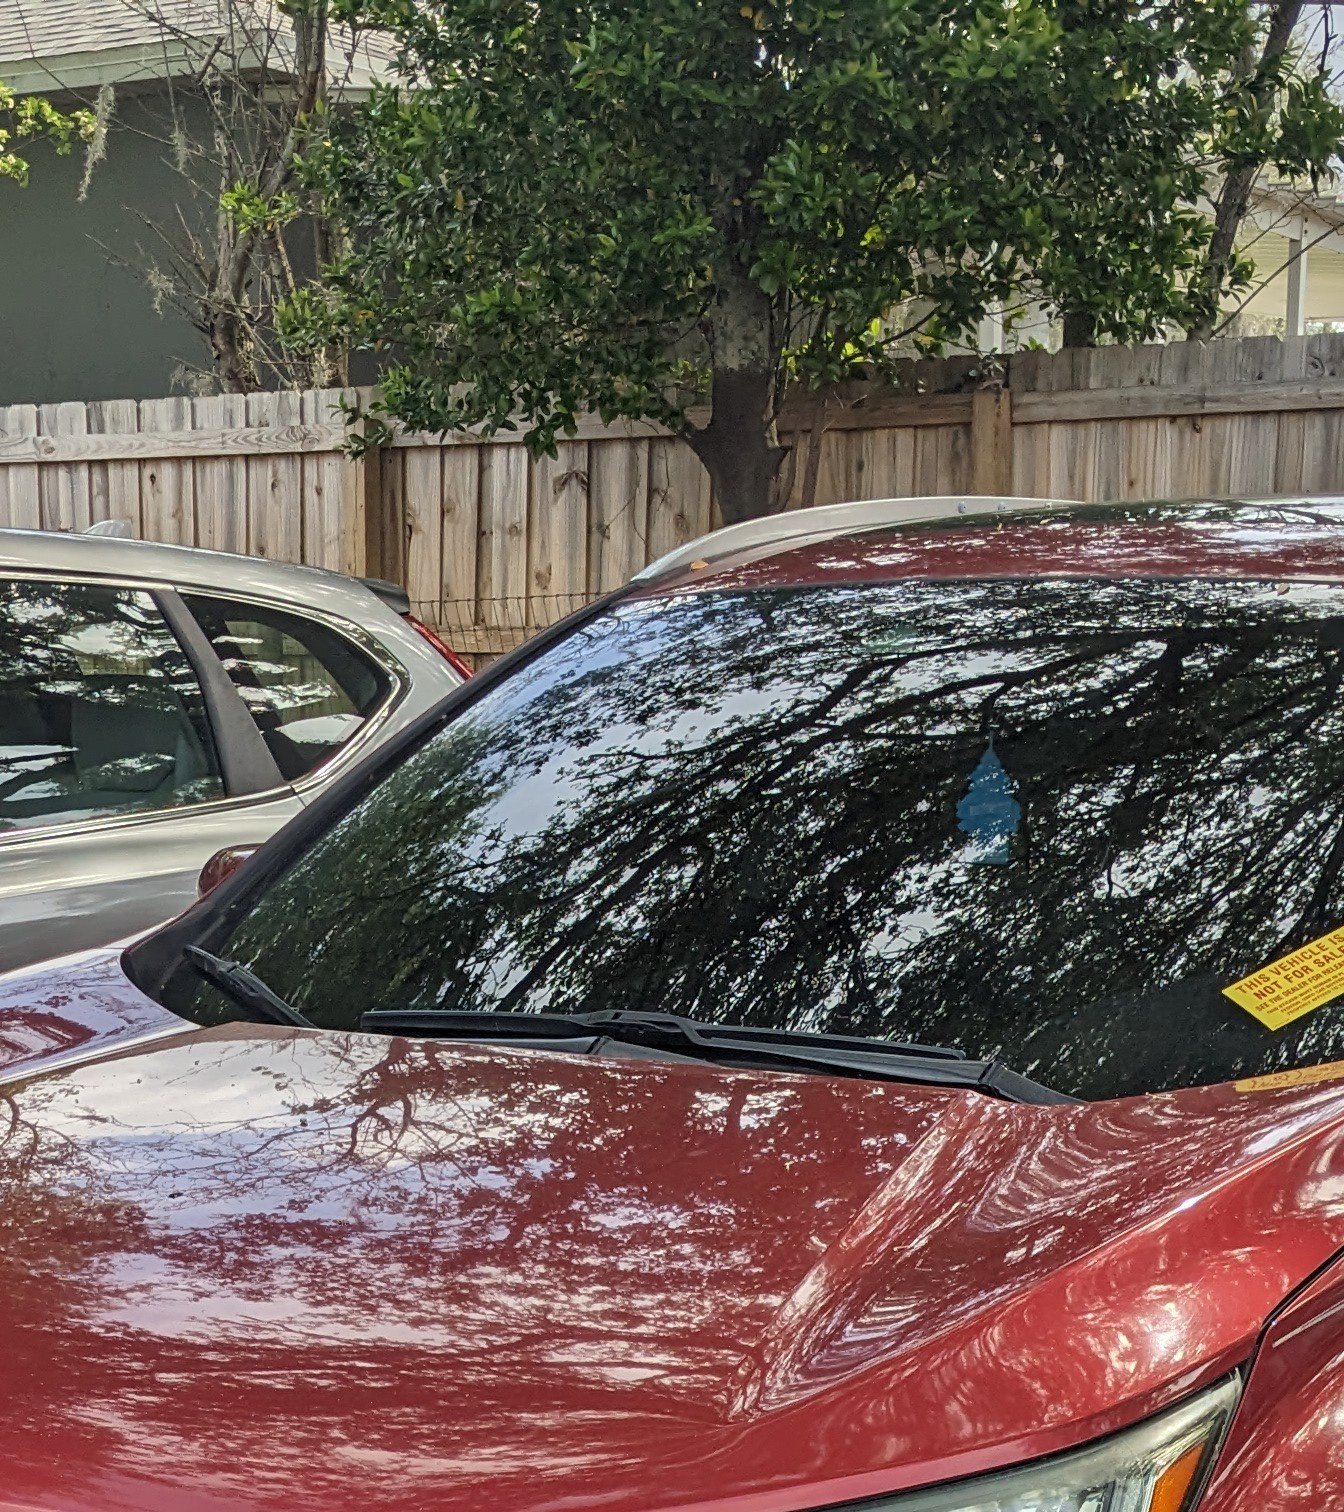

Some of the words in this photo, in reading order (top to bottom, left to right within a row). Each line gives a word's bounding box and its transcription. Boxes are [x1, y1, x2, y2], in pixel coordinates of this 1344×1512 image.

[1236, 973, 1270, 994] THIS
[1271, 943, 1328, 975] VEHICLE
[1328, 934, 1344, 945] IS
[1253, 981, 1283, 1000] NOT
[1283, 965, 1313, 983] FOR
[1269, 995, 1282, 1004] THE
[1282, 981, 1308, 997] DEALER
[1308, 973, 1323, 983] FOR
